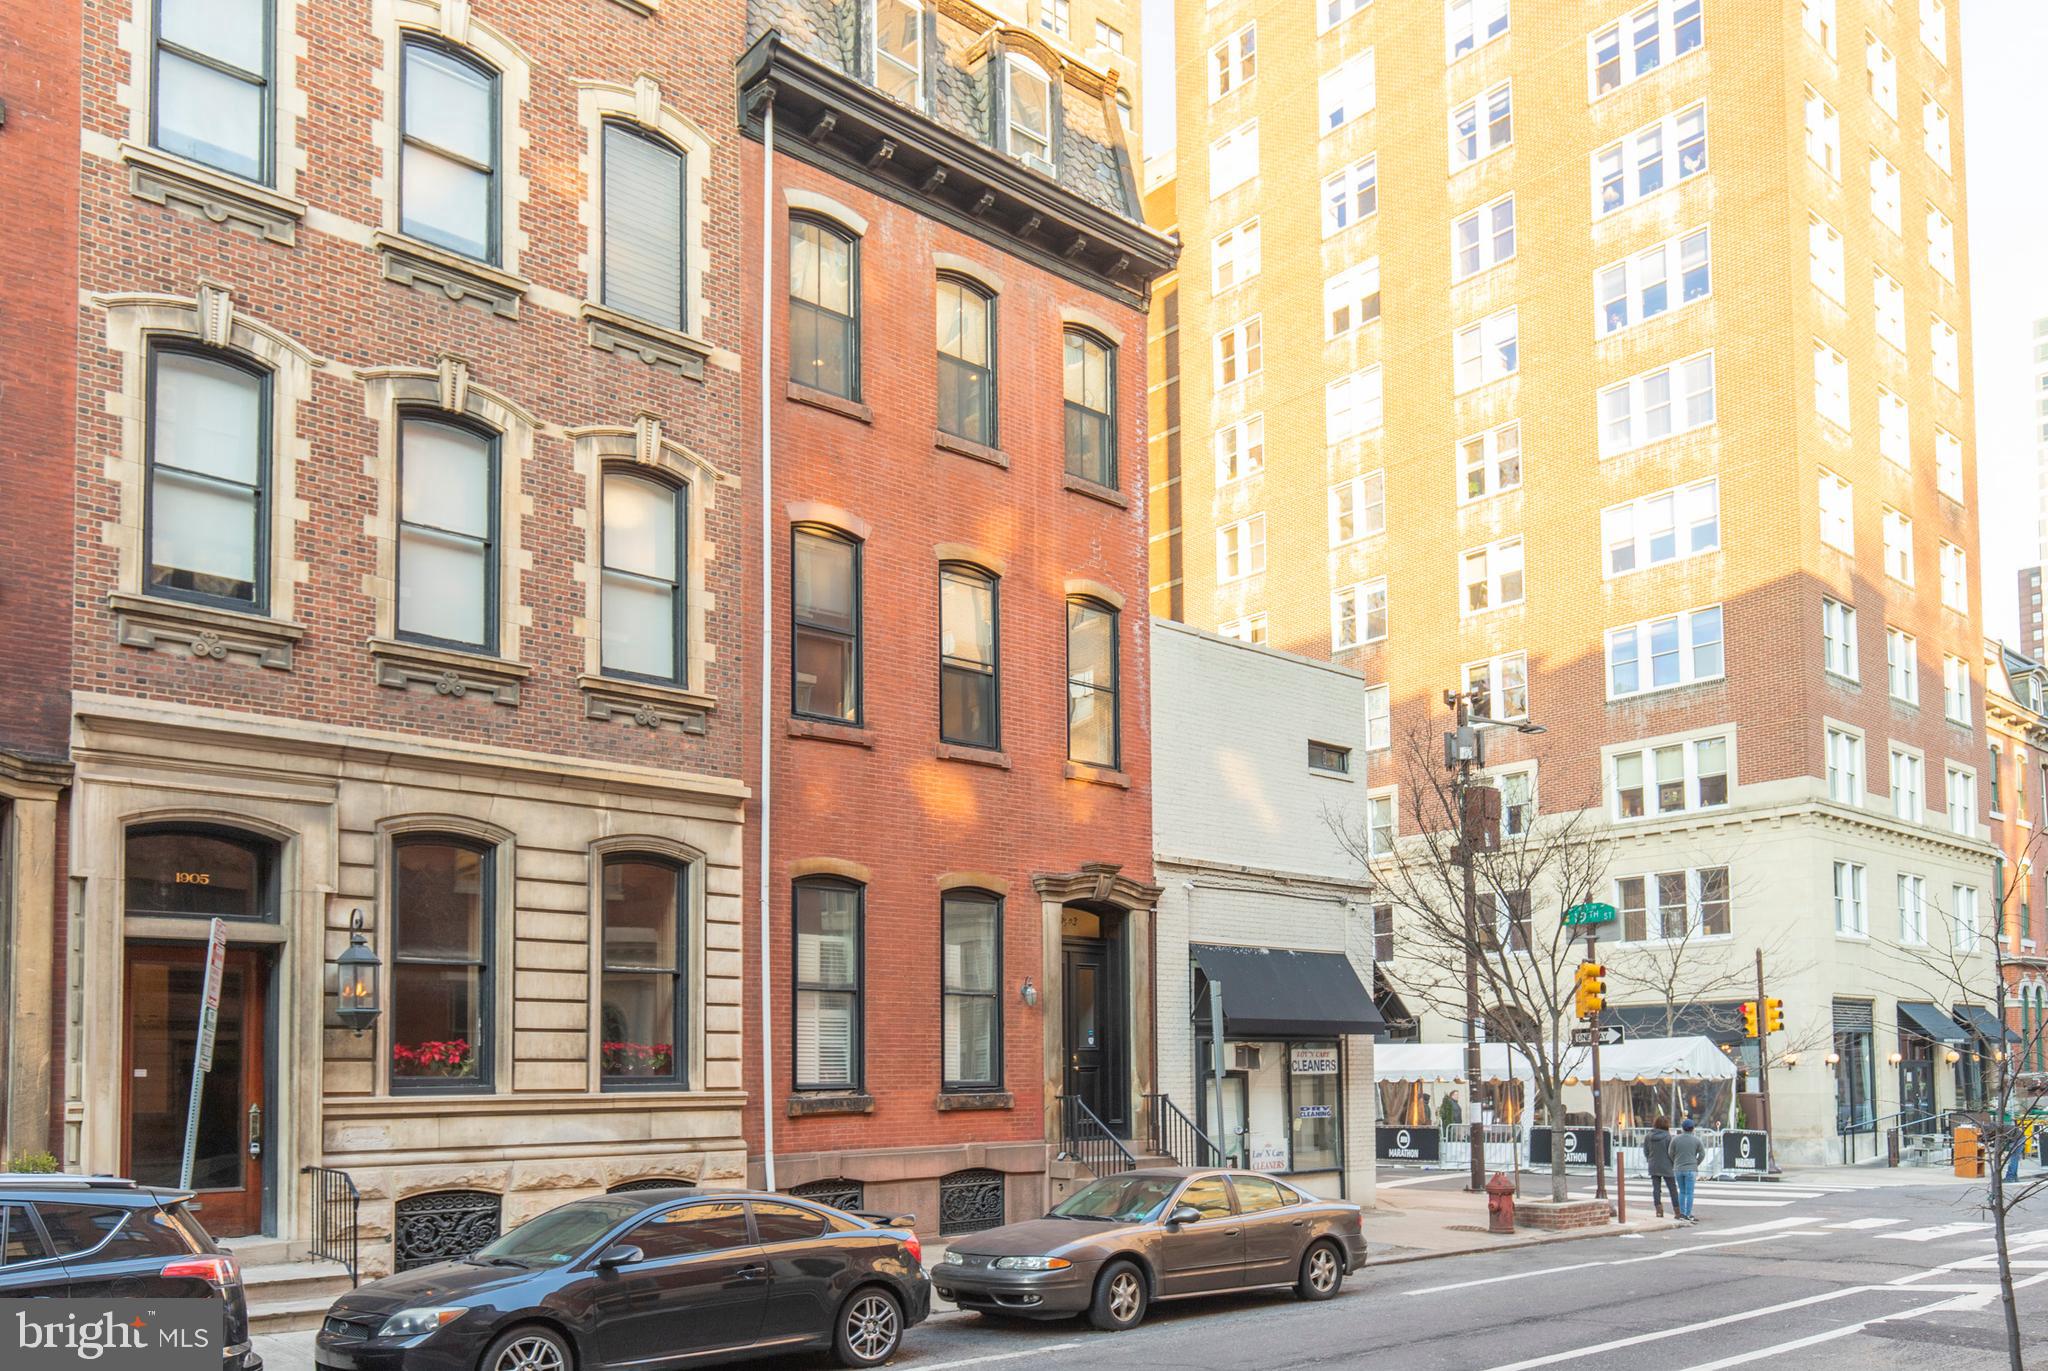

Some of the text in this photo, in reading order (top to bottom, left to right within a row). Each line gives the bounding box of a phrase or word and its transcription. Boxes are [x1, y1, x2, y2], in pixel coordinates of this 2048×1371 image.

[176, 873, 210, 885] 1905
[1603, 911, 1612, 920] ST
[1291, 1059, 1337, 1072] CLEANERS
[1388, 1148, 1419, 1158] MARATHON
[1252, 1160, 1285, 1170] CLEANERS
